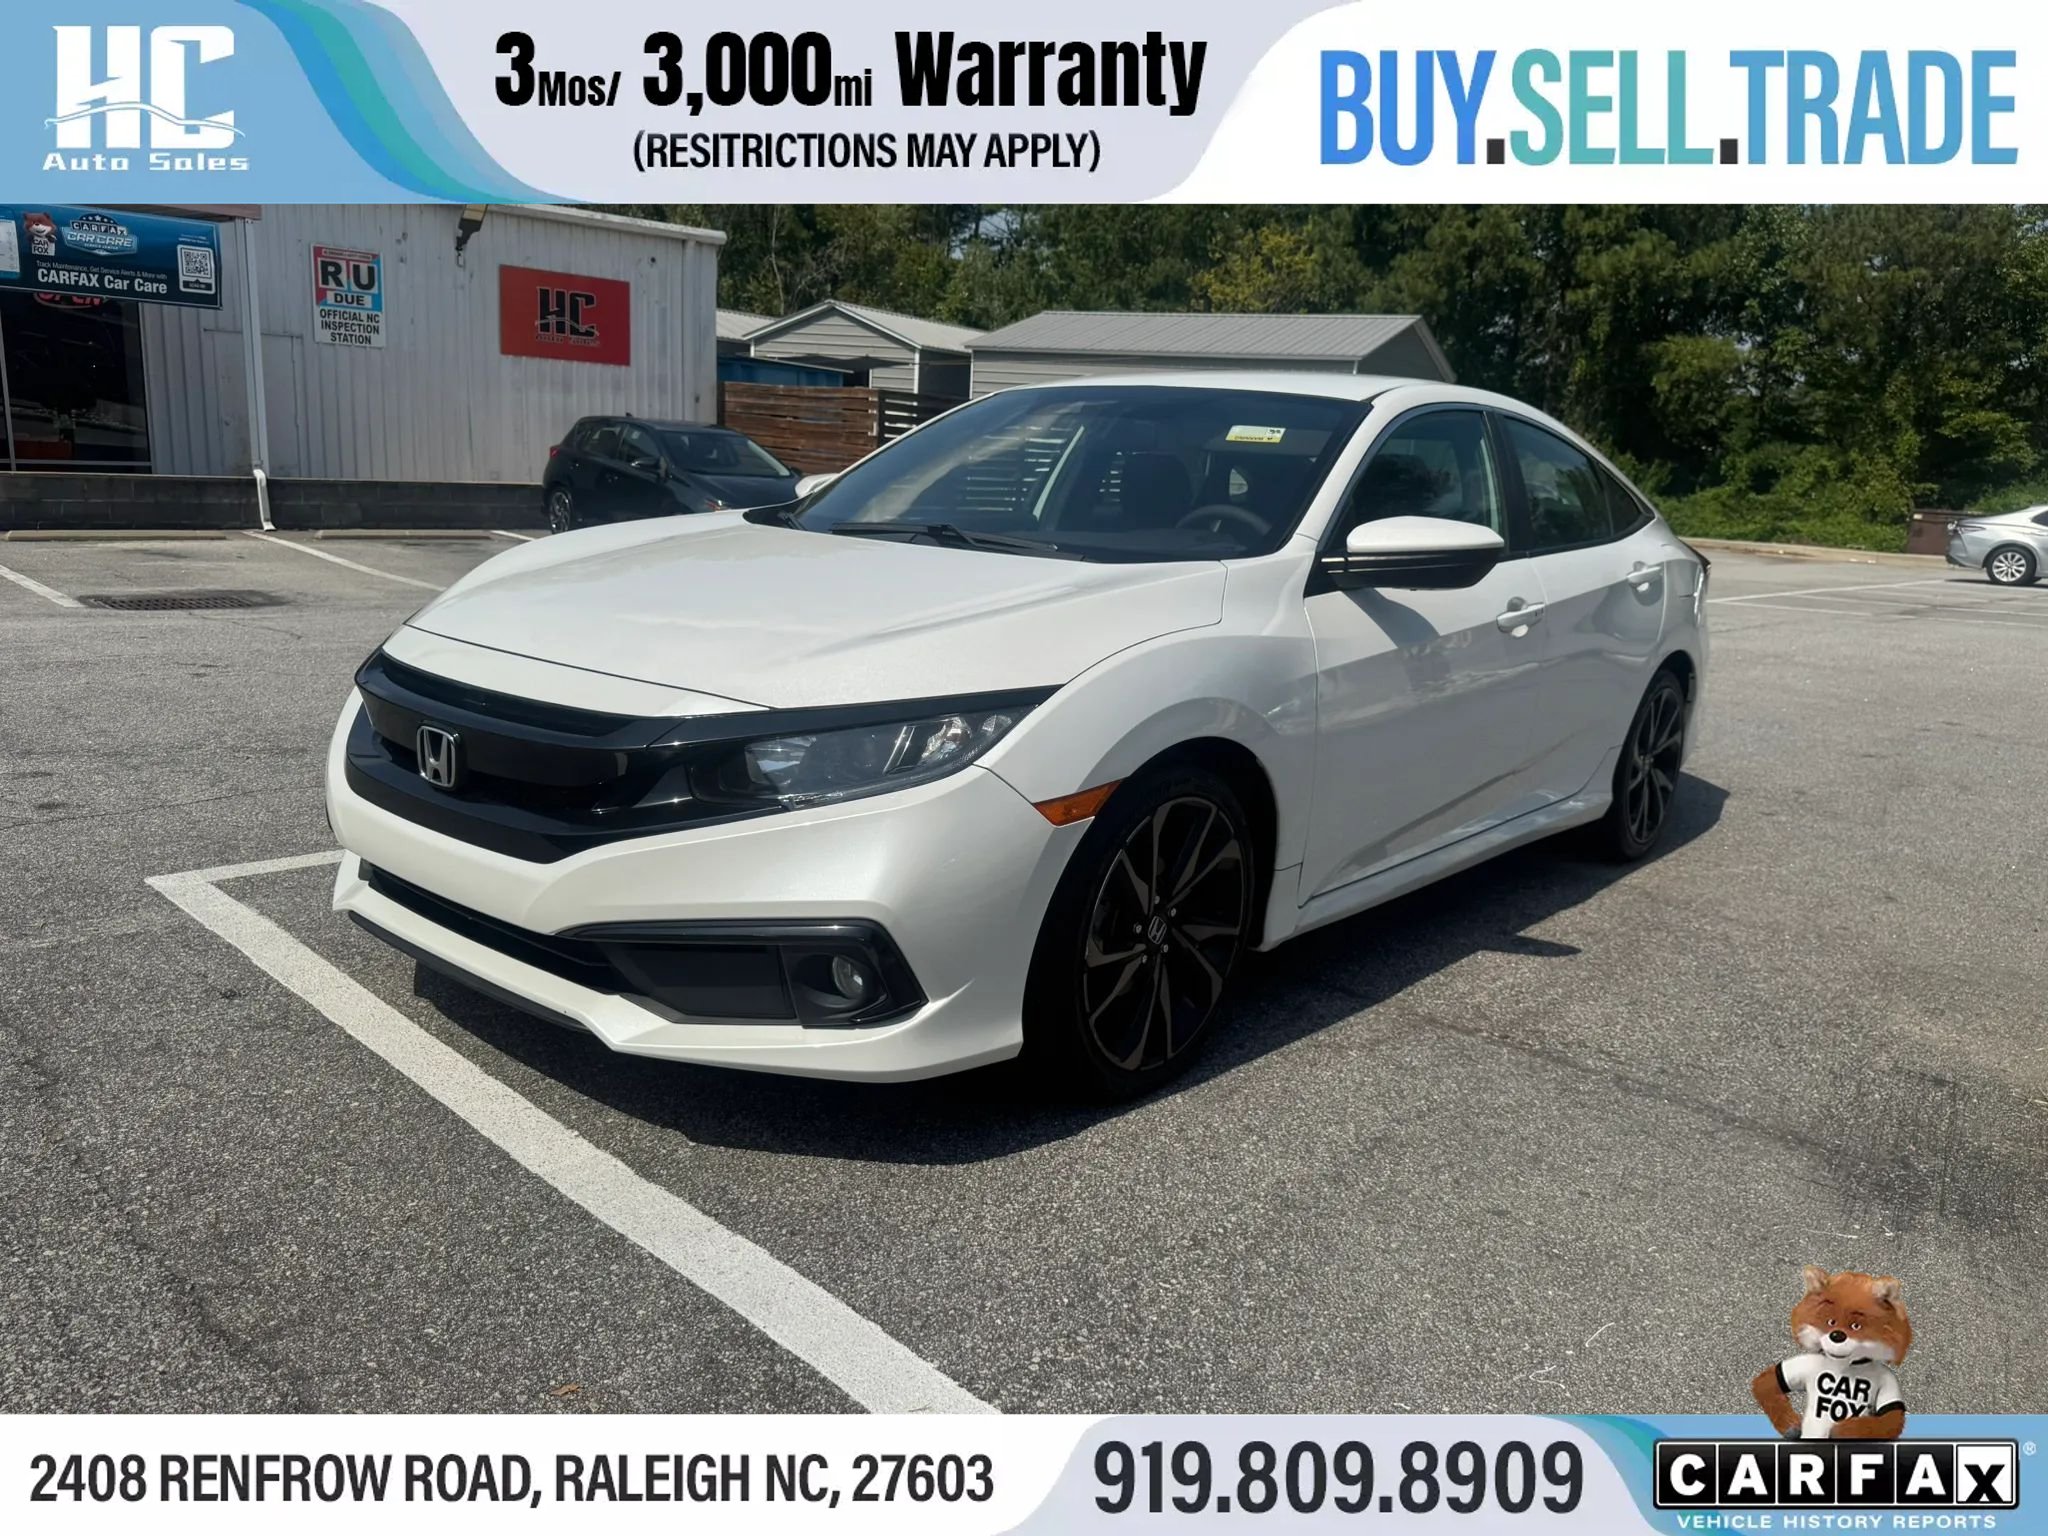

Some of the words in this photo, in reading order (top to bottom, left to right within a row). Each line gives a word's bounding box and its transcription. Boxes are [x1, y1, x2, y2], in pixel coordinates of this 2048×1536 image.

[37, 268, 100, 288] CARFAX
[104, 274, 130, 290] Car
[134, 278, 168, 294] Care
[334, 292, 366, 306] DUE
[320, 308, 364, 323] OFFICIAL
[366, 313, 380, 324] NC
[538, 287, 597, 338] HC
[321, 320, 380, 335] INSPECTION
[330, 332, 372, 345] STATION
